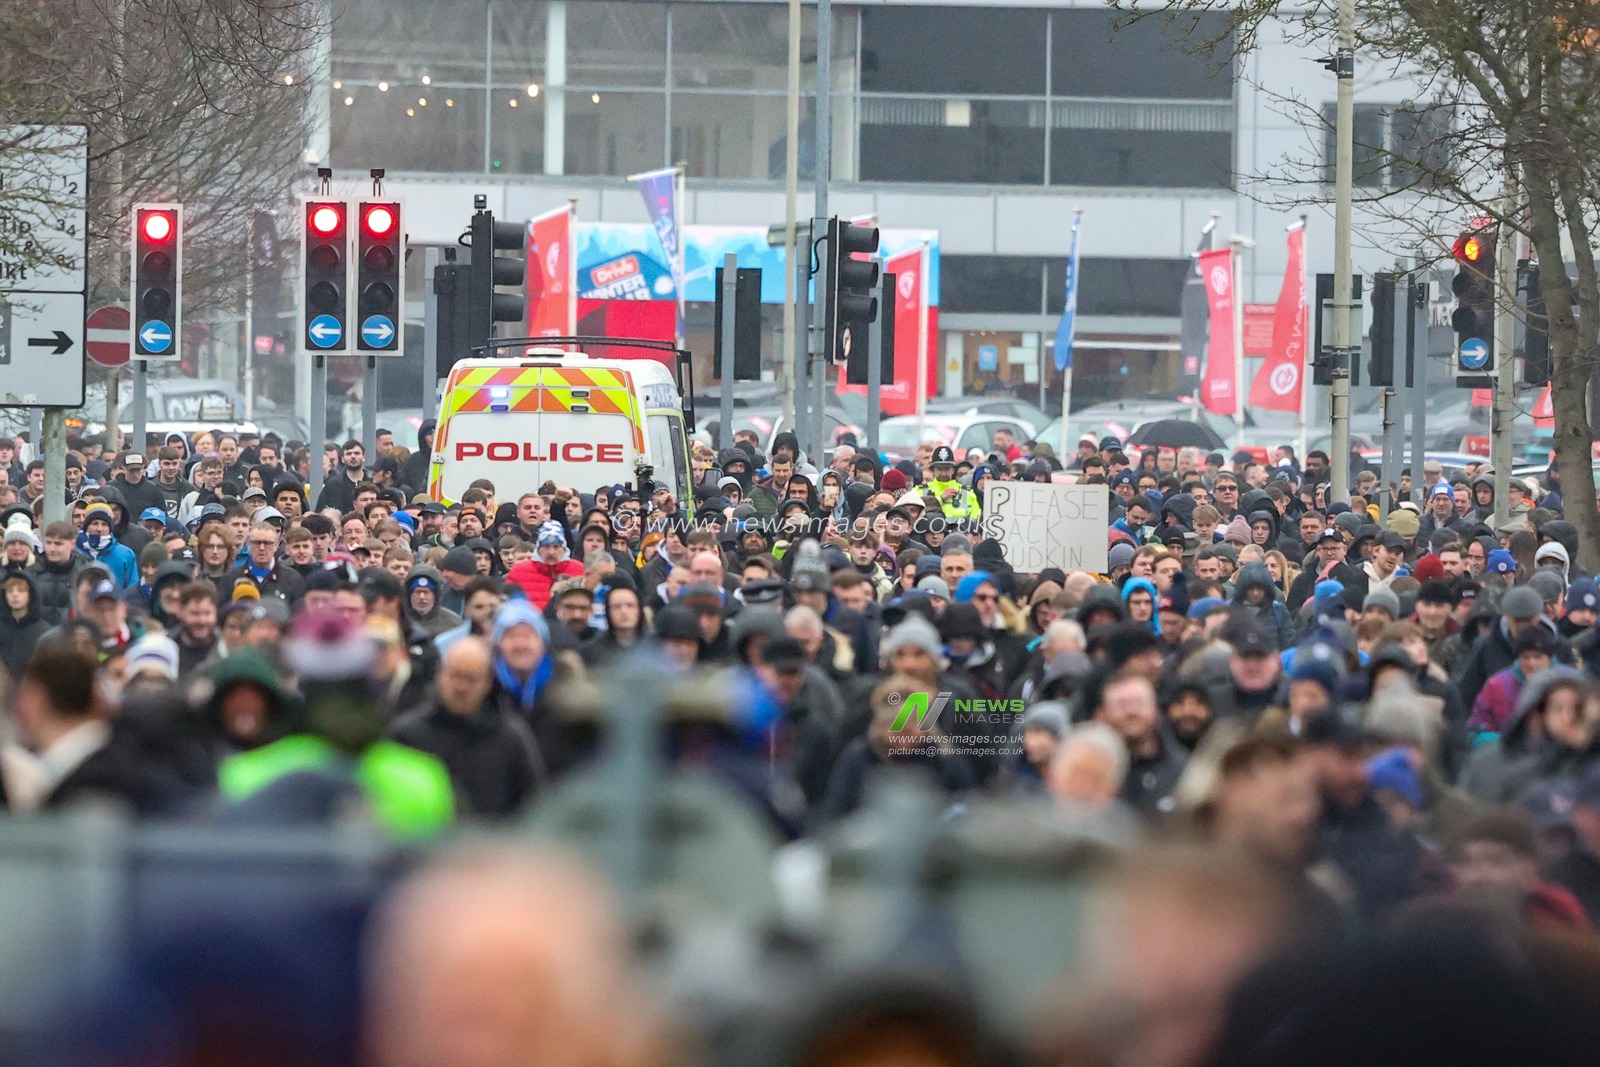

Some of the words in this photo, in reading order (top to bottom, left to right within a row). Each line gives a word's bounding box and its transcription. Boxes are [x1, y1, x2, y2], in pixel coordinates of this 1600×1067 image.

[456, 443, 624, 463] POLICE
[991, 487, 1099, 520] PLEASE
[986, 515, 1061, 547] SACK
